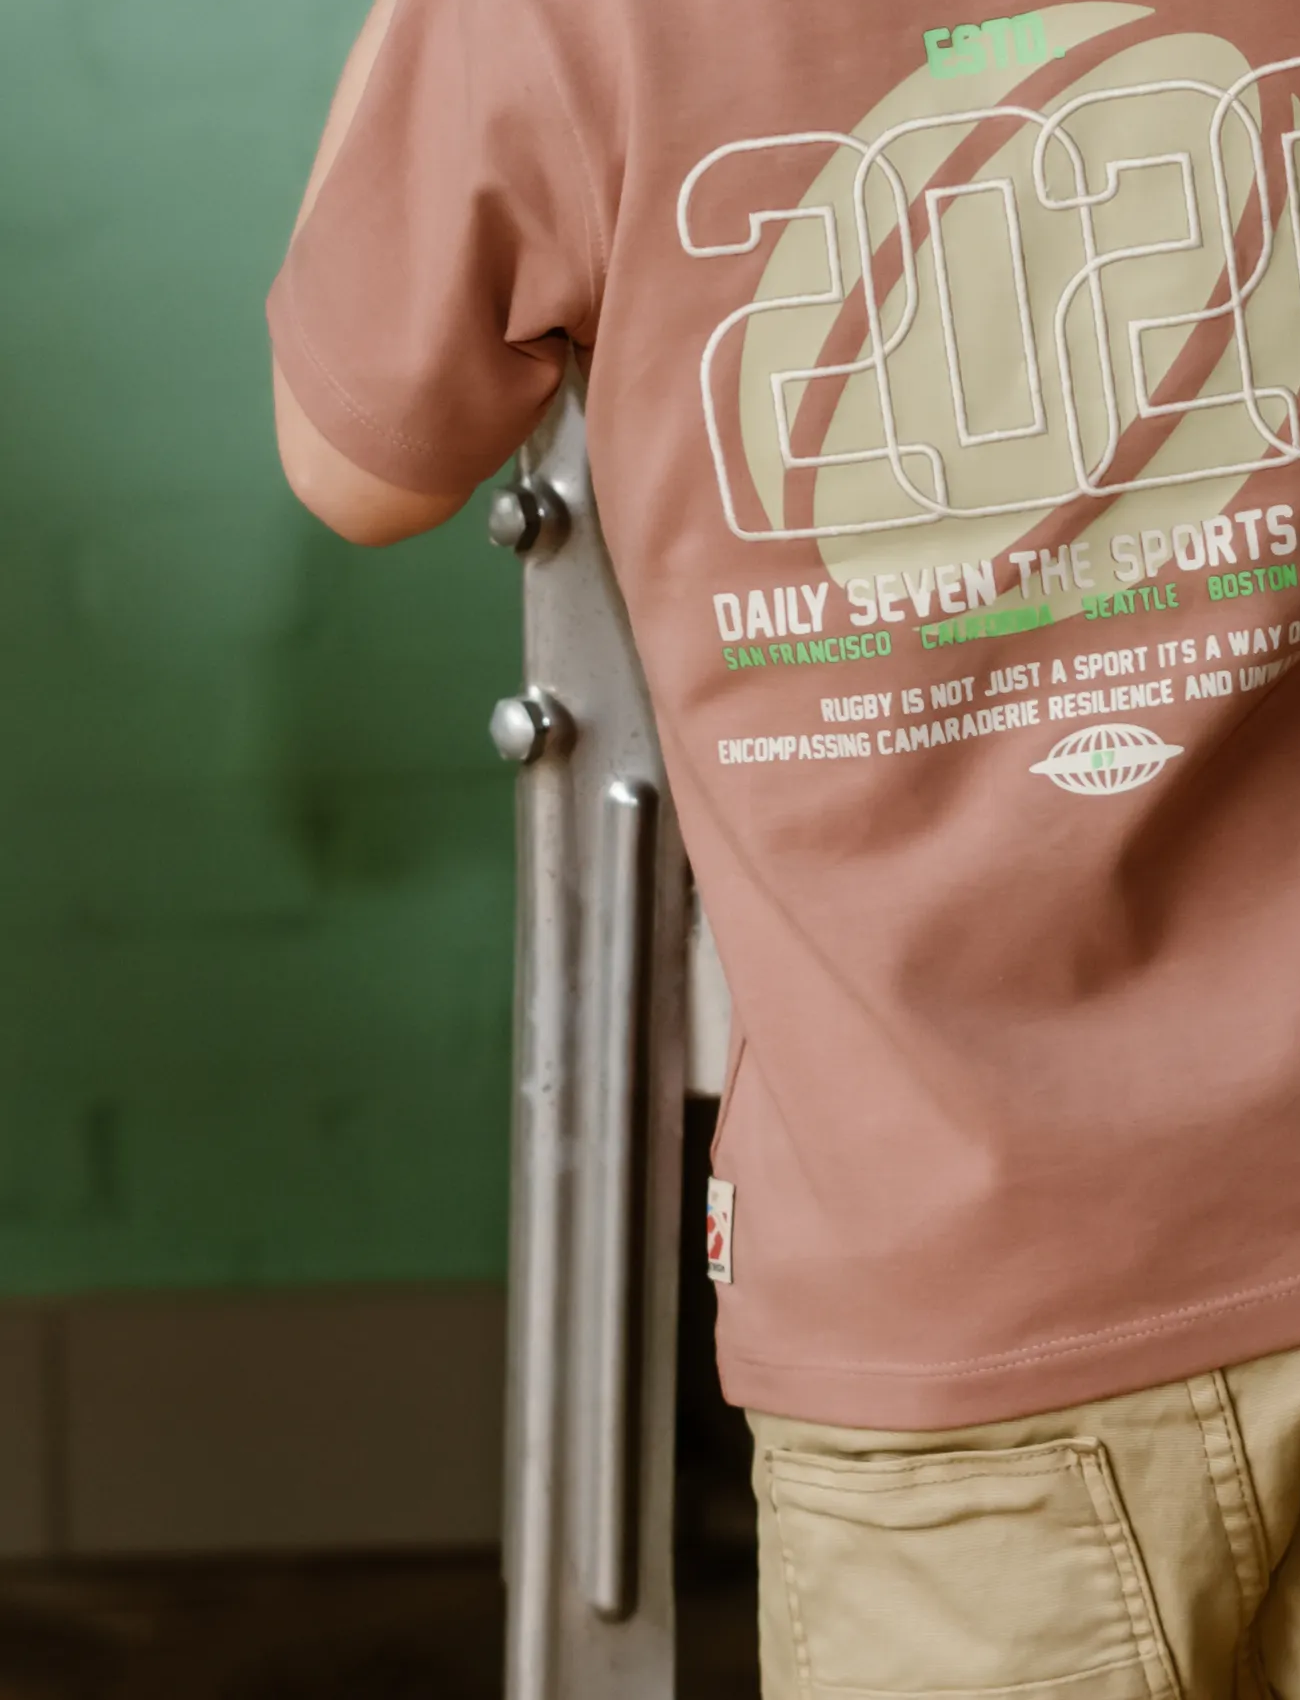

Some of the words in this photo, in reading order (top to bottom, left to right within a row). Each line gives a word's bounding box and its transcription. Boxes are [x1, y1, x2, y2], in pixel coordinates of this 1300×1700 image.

[713, 582, 829, 642] DAILY
[846, 558, 997, 626] SEVEN
[1008, 540, 1095, 600] THE
[1110, 504, 1298, 583] SPORTS
[723, 647, 766, 671] SAN
[770, 630, 892, 666] FRANCISCO
[1081, 583, 1180, 621] SEATTLE
[1207, 563, 1299, 601] BOSTON
[717, 732, 872, 765] ENCOMPASSING
[876, 700, 1041, 756] CAMARADERIE
[1047, 678, 1175, 721] RESILIENCE
[1184, 670, 1233, 702] AND
[820, 692, 892, 723] RUGBY
[901, 688, 924, 715] IS
[930, 676, 975, 710] NOT
[984, 661, 1041, 697] JUST
[1050, 658, 1067, 684] A
[1073, 646, 1148, 682] SPORT
[1157, 637, 1197, 668] ITS
[1205, 634, 1222, 661] A
[1227, 624, 1282, 657] WAY
